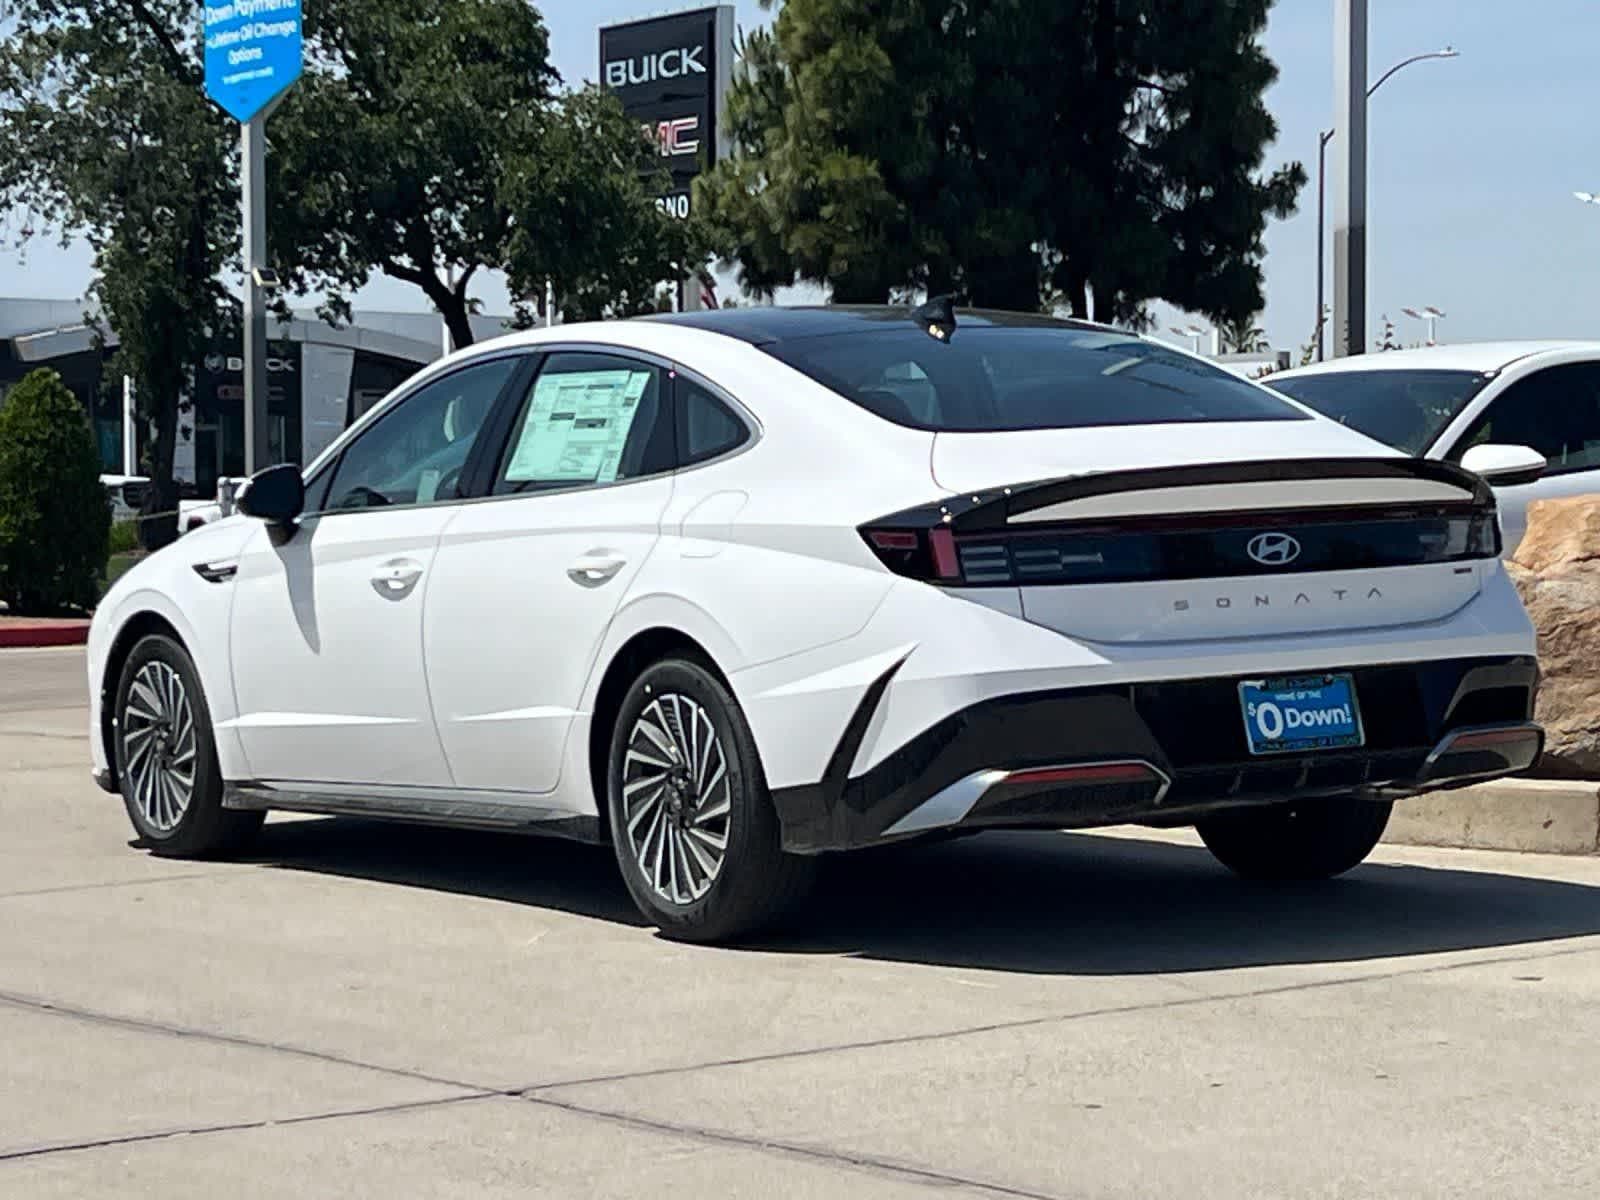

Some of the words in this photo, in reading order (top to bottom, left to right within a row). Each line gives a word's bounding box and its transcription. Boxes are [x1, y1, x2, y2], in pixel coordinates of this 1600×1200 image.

[606, 46, 706, 87] BUICK
[641, 117, 699, 157] MC
[1173, 587, 1382, 611] SONATA
[1247, 701, 1284, 739] $0
[1284, 703, 1353, 729] Down!
